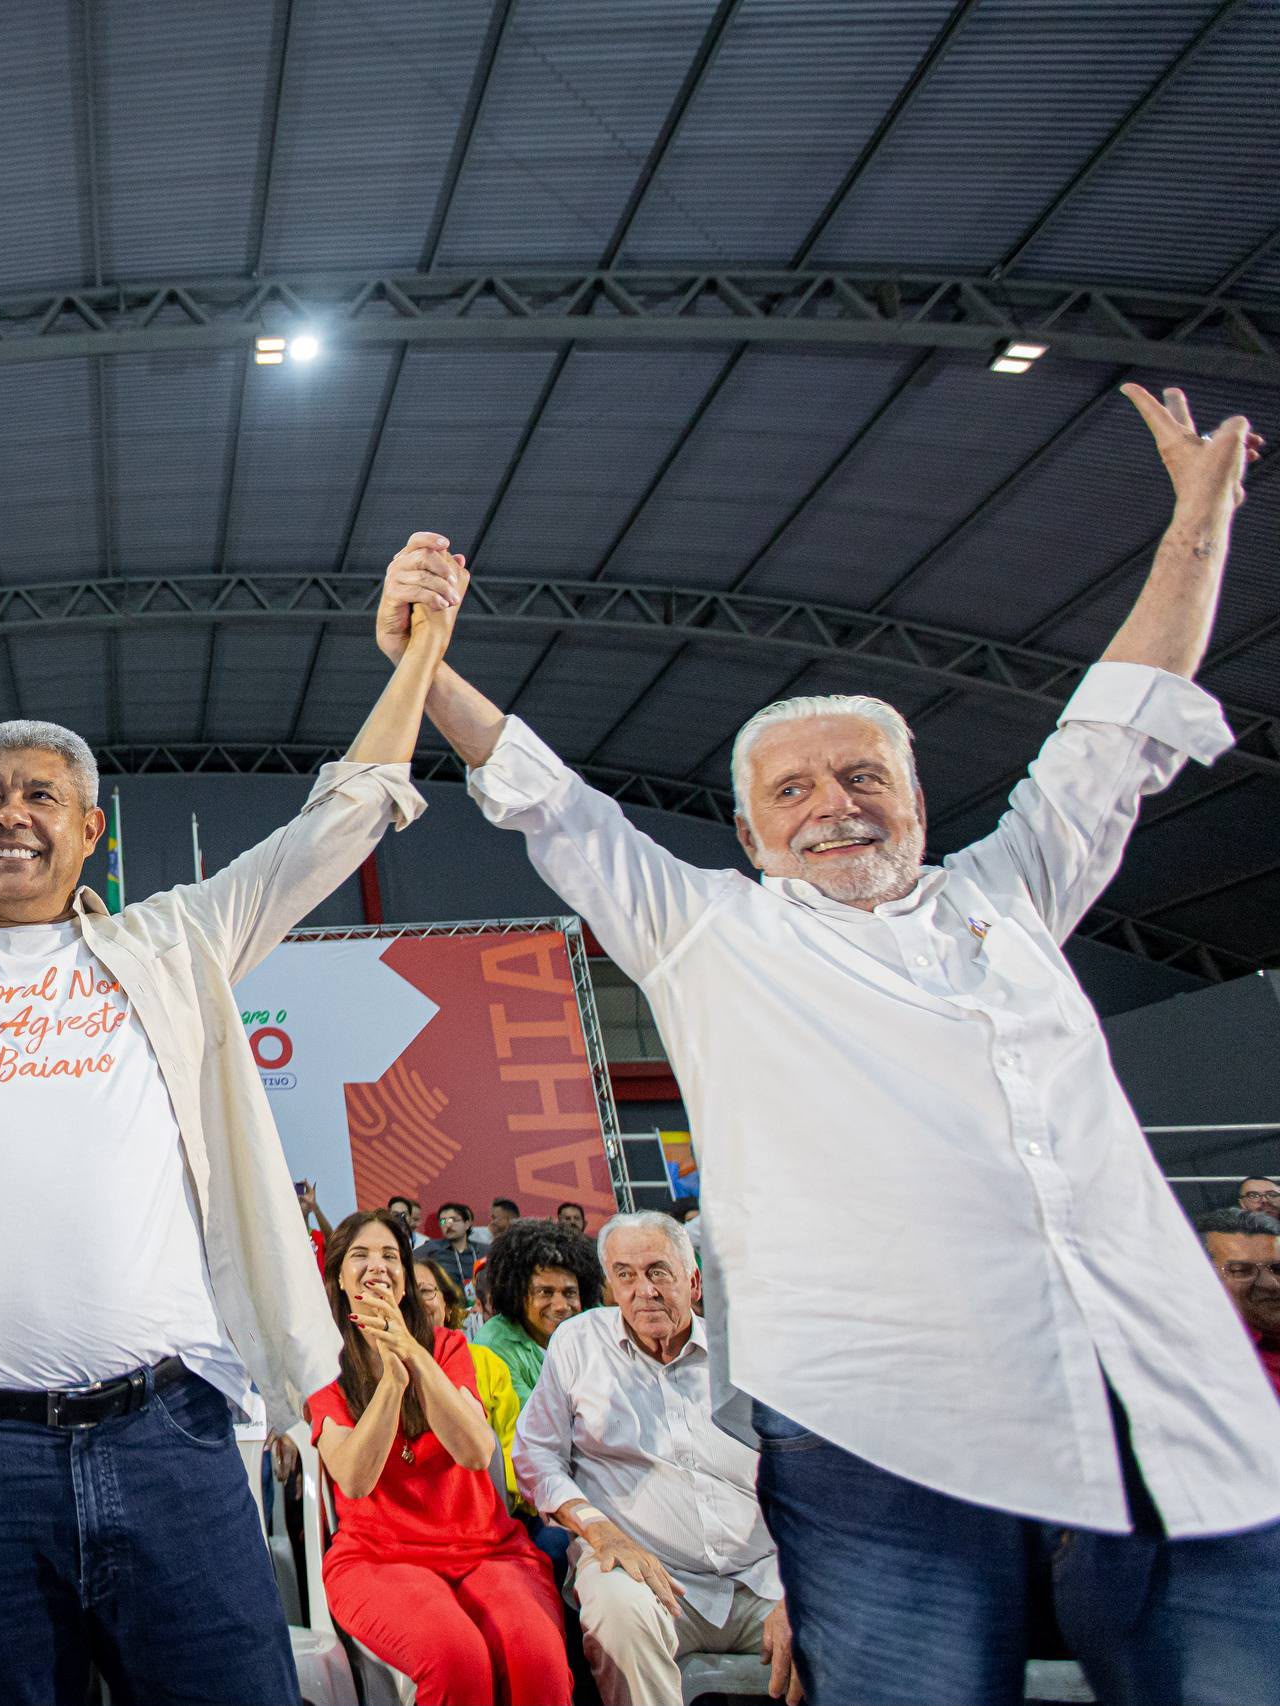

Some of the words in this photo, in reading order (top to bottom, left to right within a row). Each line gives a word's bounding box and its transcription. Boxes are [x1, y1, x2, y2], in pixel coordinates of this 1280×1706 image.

[69, 966, 120, 1000] Nor
[241, 1009, 270, 1025] ara
[248, 1026, 294, 1070] O
[262, 1076, 290, 1087] TIVO
[480, 932, 617, 1238] AHIA
